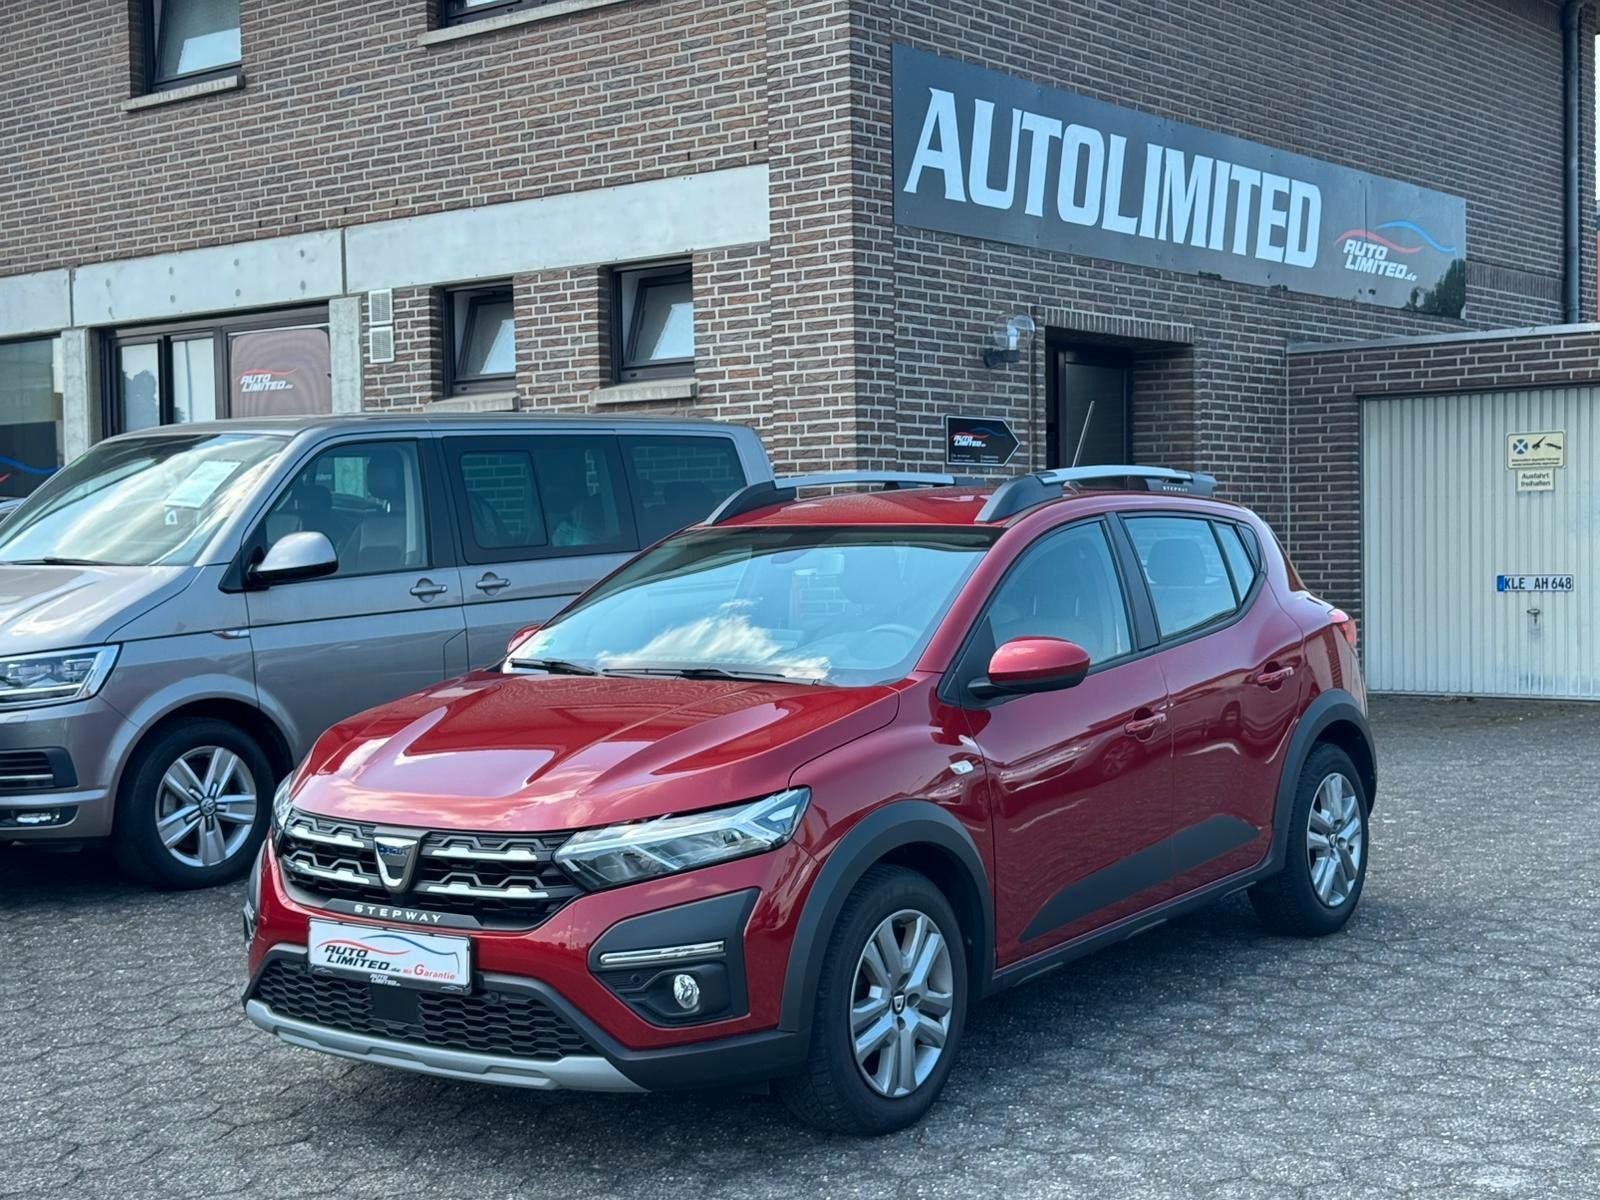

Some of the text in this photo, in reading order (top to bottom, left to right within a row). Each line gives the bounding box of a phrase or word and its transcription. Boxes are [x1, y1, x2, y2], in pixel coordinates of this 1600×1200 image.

[903, 87, 1322, 269] AUTOLIMITED
[1343, 239, 1388, 260] AUTO
[240, 374, 272, 384] AUTO
[1504, 577, 1572, 590] KLE AH 648
[354, 904, 442, 924] STEPWAY
[325, 944, 368, 958] AUTO
[414, 963, 456, 980] Garantie
